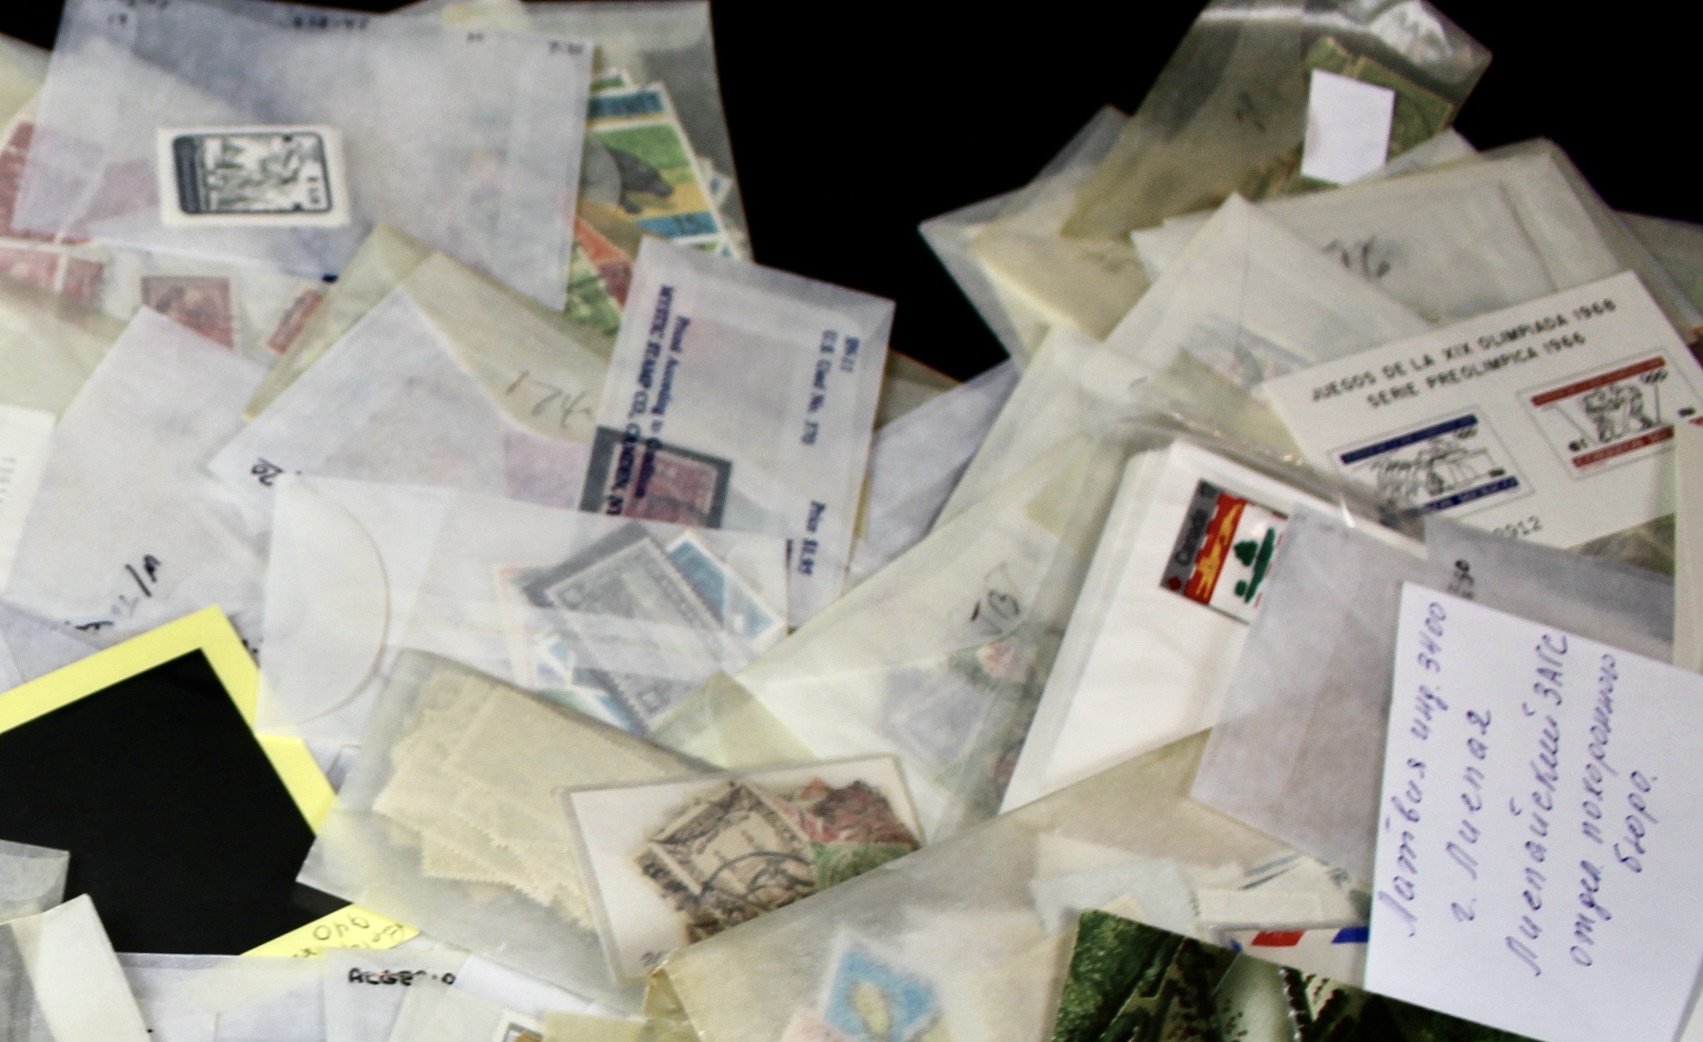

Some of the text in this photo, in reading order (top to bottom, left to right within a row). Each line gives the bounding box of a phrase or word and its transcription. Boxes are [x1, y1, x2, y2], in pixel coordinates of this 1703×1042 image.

[1311, 370, 1377, 403] JUEGOS
[1382, 361, 1407, 382] DE
[1411, 352, 1435, 374] LA
[1442, 341, 1474, 364] XIX
[1477, 312, 1570, 352] OLIMPIADA
[1367, 381, 1420, 410] SERIE
[1417, 601, 1447, 674] 3400
